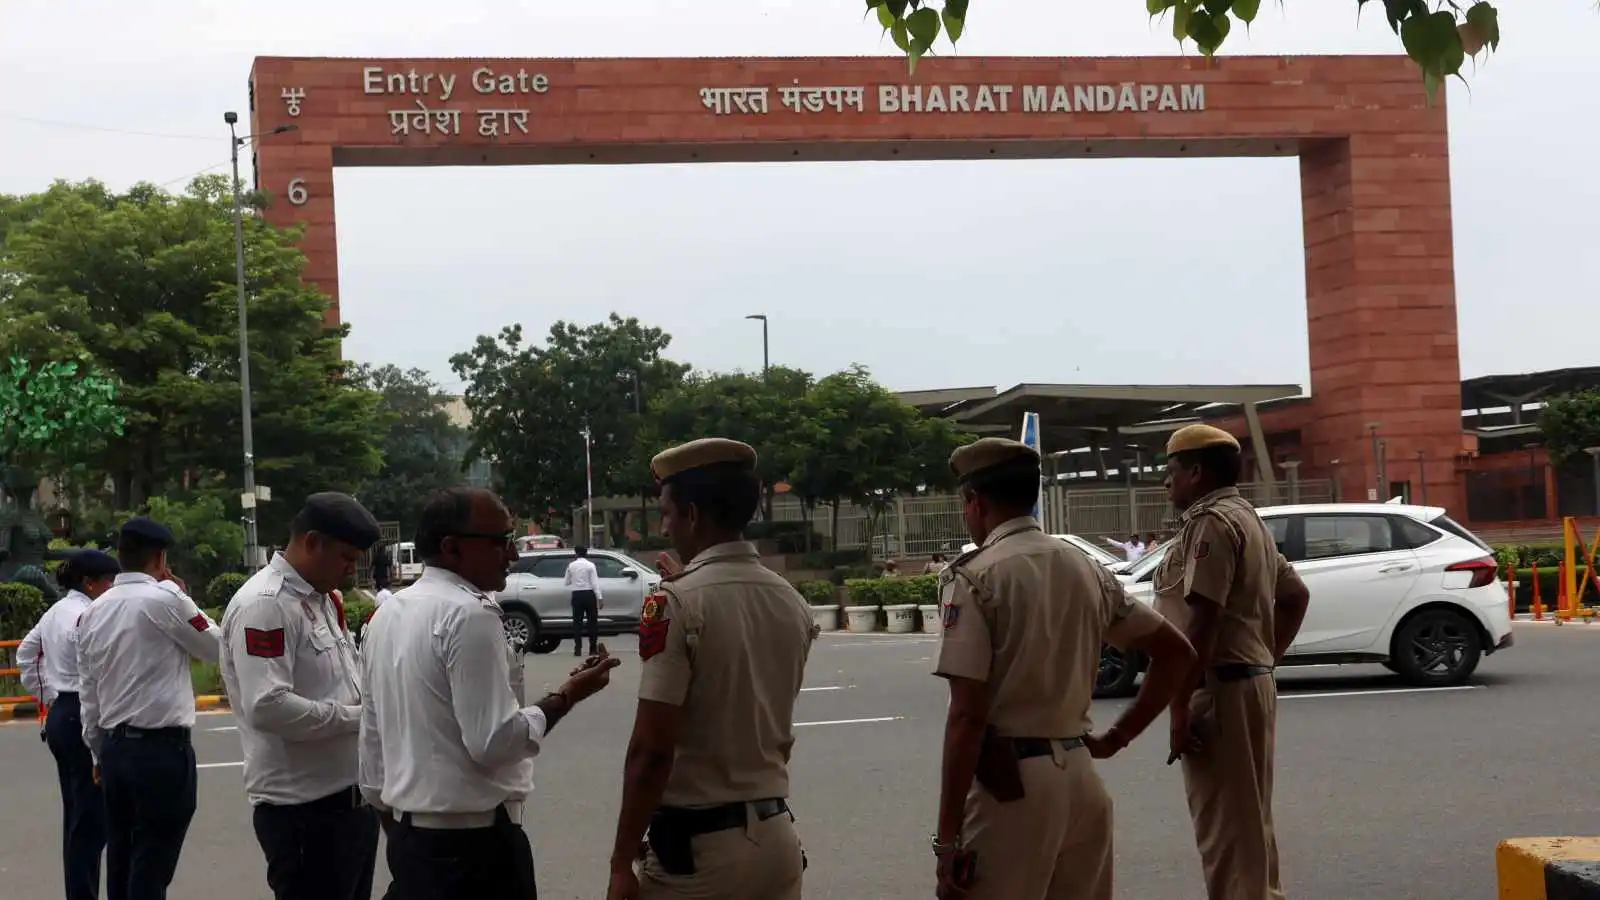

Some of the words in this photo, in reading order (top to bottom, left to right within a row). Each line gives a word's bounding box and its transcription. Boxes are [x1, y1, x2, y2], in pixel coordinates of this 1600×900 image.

[363, 67, 456, 100] Entry
[472, 67, 549, 93] Gate
[700, 87, 769, 114] भारत
[778, 78, 865, 113] मंडपम
[879, 84, 1013, 112] BHARAT
[388, 99, 461, 135] प्रवेश
[477, 109, 530, 136] द्वार
[287, 177, 308, 204] 6
